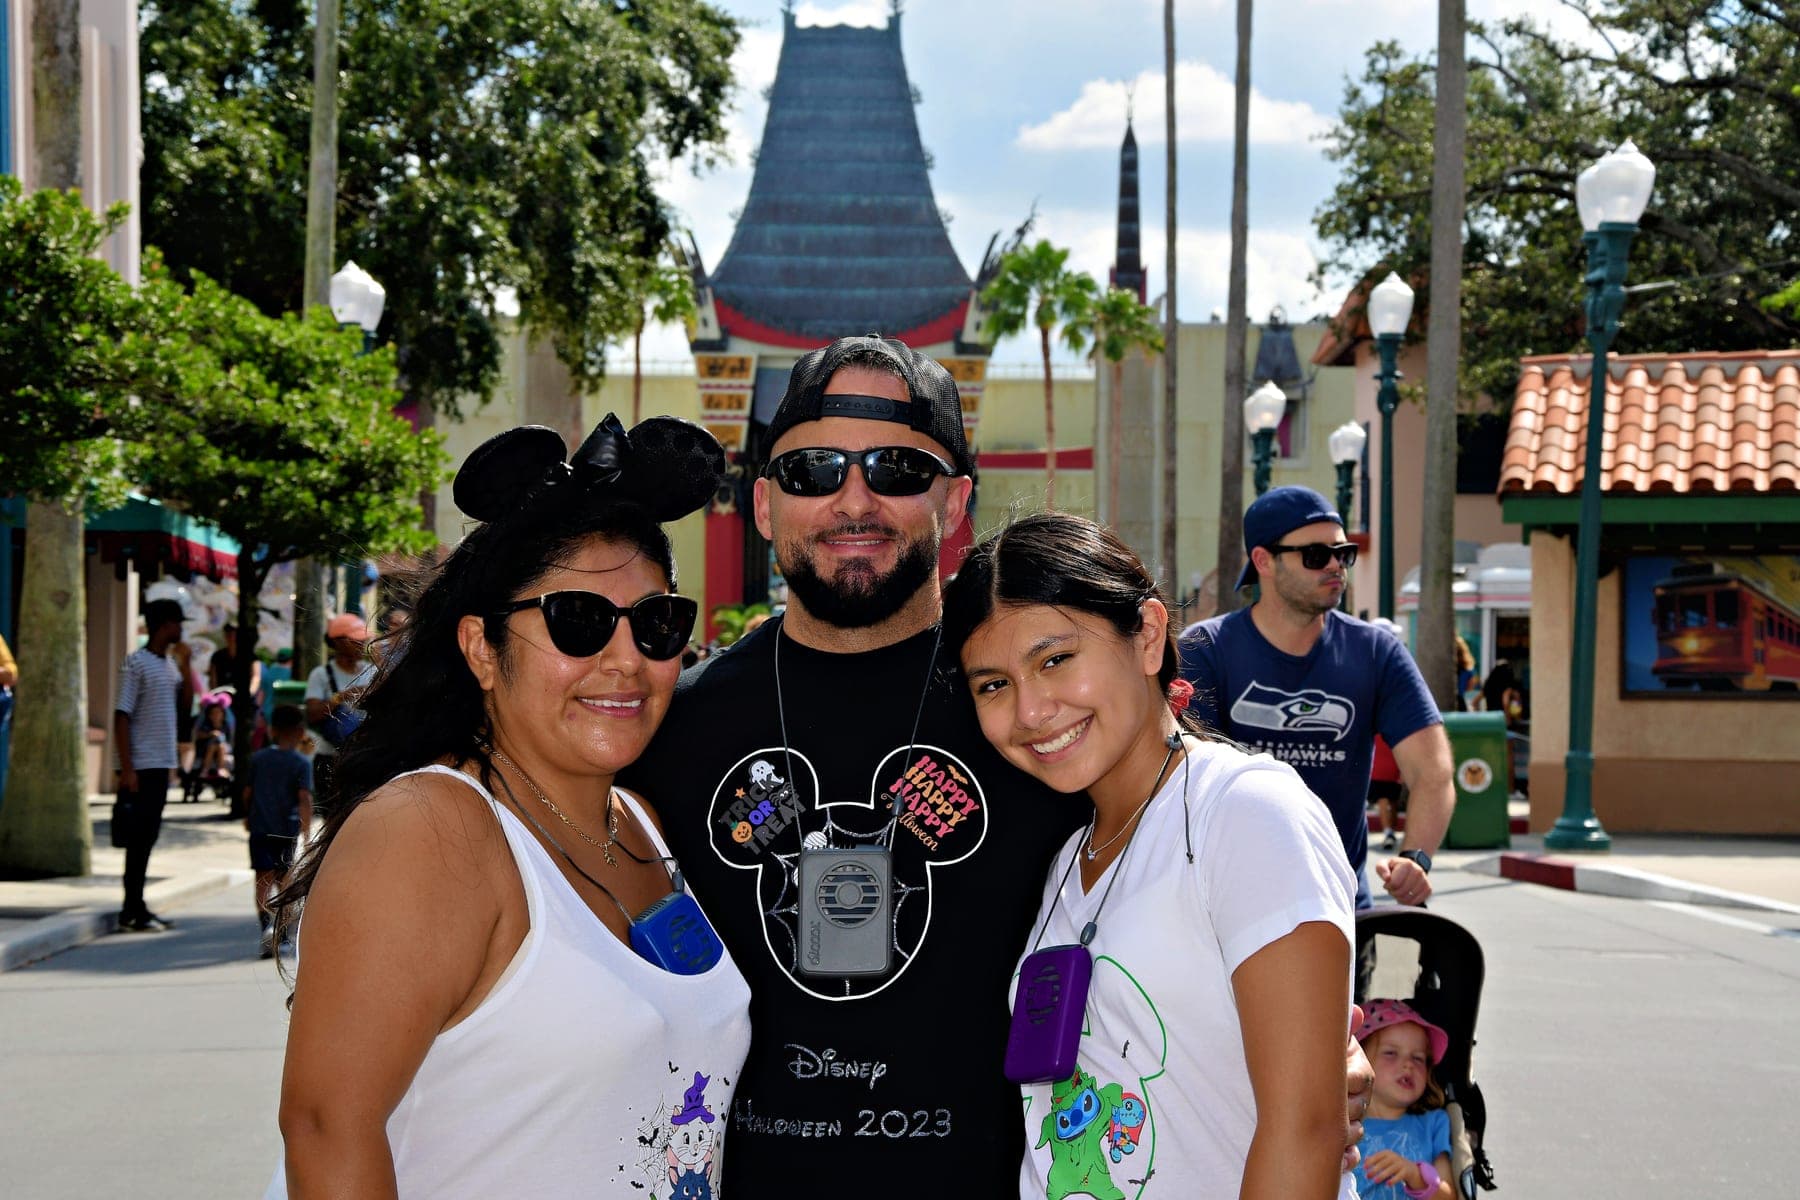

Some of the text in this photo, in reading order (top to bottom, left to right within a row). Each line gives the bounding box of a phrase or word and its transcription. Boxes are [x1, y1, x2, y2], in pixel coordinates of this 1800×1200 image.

[719, 772, 785, 826] TRICK
[748, 799, 776, 825] OR
[889, 777, 955, 838] HAPPY
[904, 766, 968, 827] HAPPY
[914, 755, 980, 816] HAPPY
[741, 791, 807, 856] TREAT
[784, 1043, 888, 1090] Disney
[854, 1108, 952, 1138] 2023
